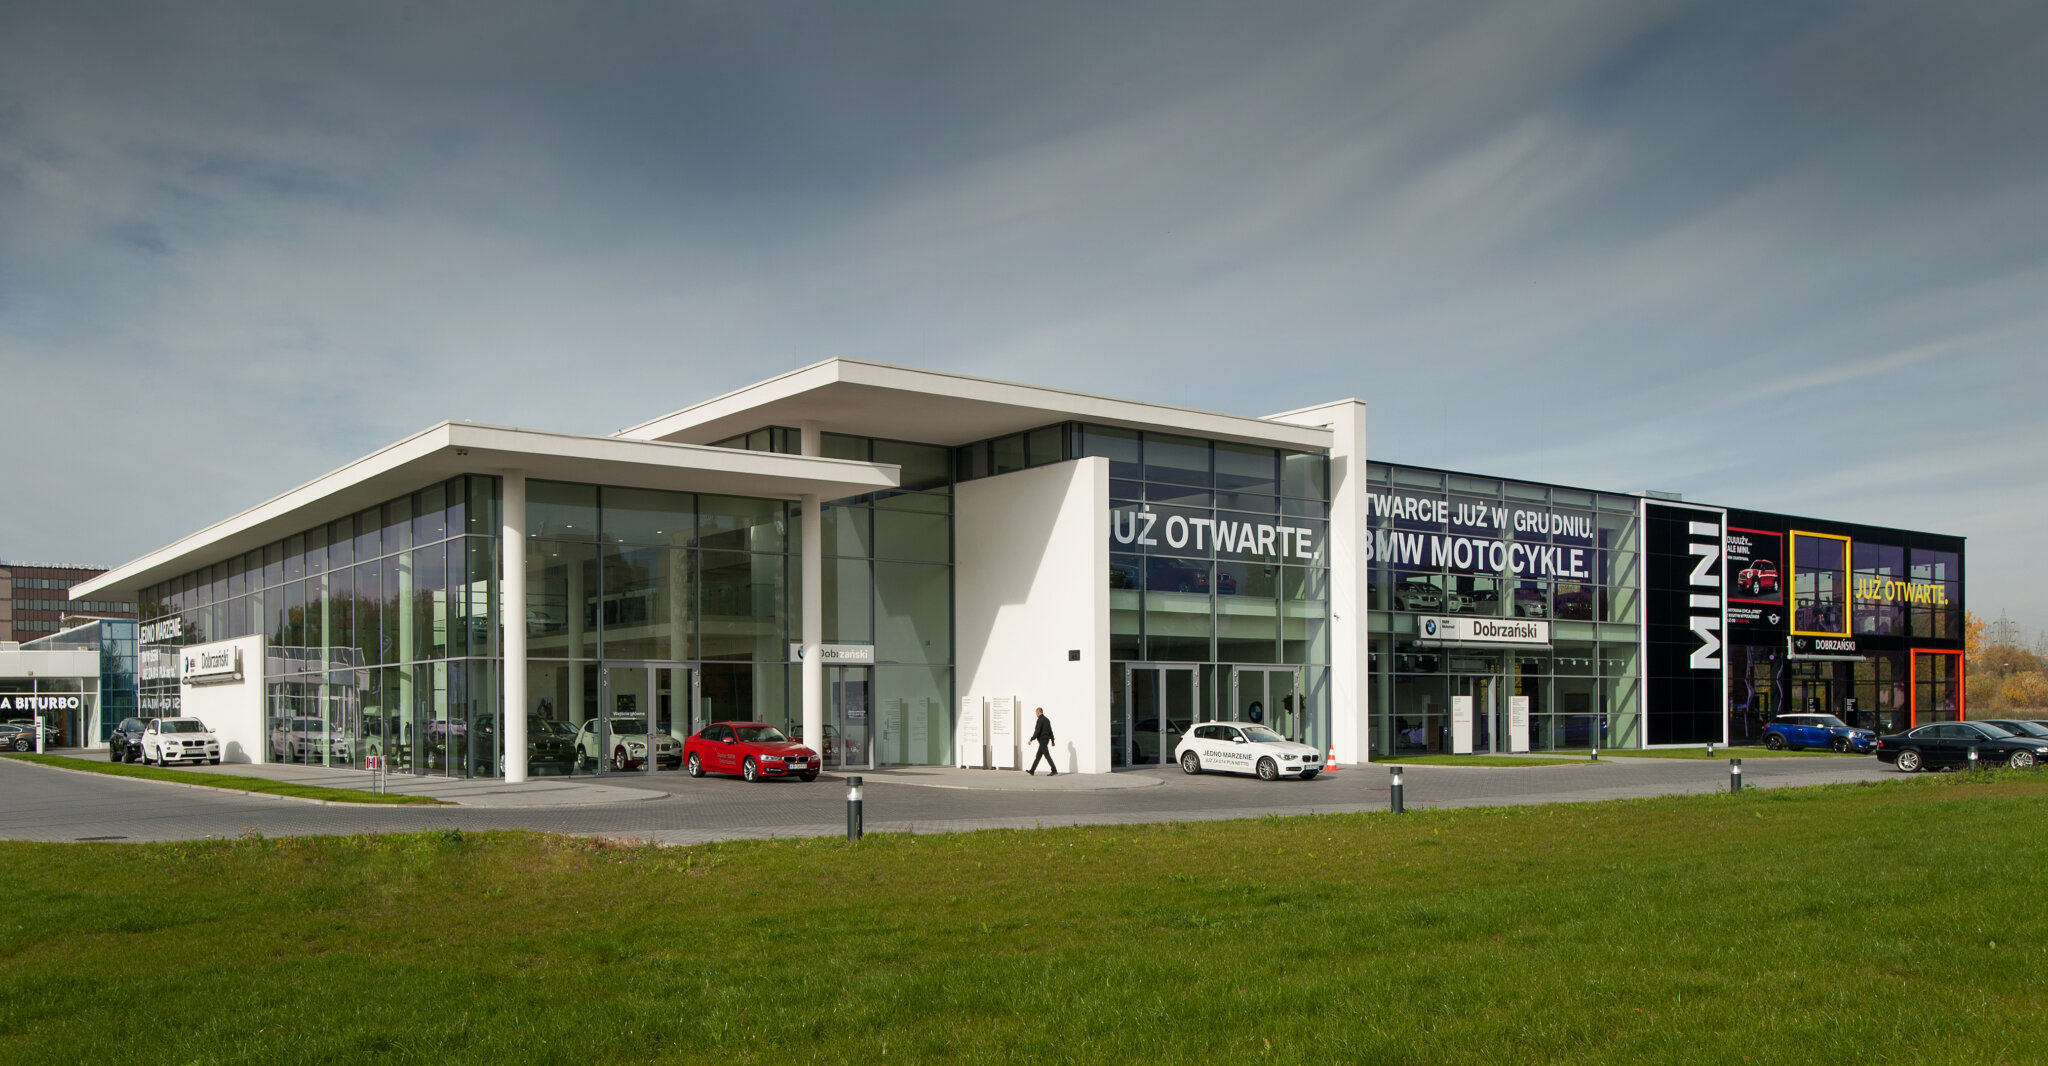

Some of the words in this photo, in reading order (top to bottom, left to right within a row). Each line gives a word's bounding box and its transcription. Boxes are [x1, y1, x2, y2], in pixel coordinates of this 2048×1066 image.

[1109, 504, 1157, 547] UŻ
[1165, 515, 1319, 559] OTWARTE.
[1453, 501, 1488, 528] JUŻ
[1492, 507, 1508, 529] W
[1513, 509, 1594, 539] GRUDNIU.
[1431, 535, 1589, 578] MOTOCYKLE.
[1689, 521, 1720, 669] MINI
[1855, 574, 1882, 600] JUŻ
[1884, 580, 1949, 605] OTWARTE.
[1473, 621, 1538, 638] Dobrzański
[1815, 638, 1856, 651] DOBRZAŃSKI
[202, 649, 229, 669] Dobrzański
[15, 696, 79, 710] BITURBO
[1203, 750, 1222, 758] JEDNO
[1222, 752, 1254, 761] MARZENIE.
